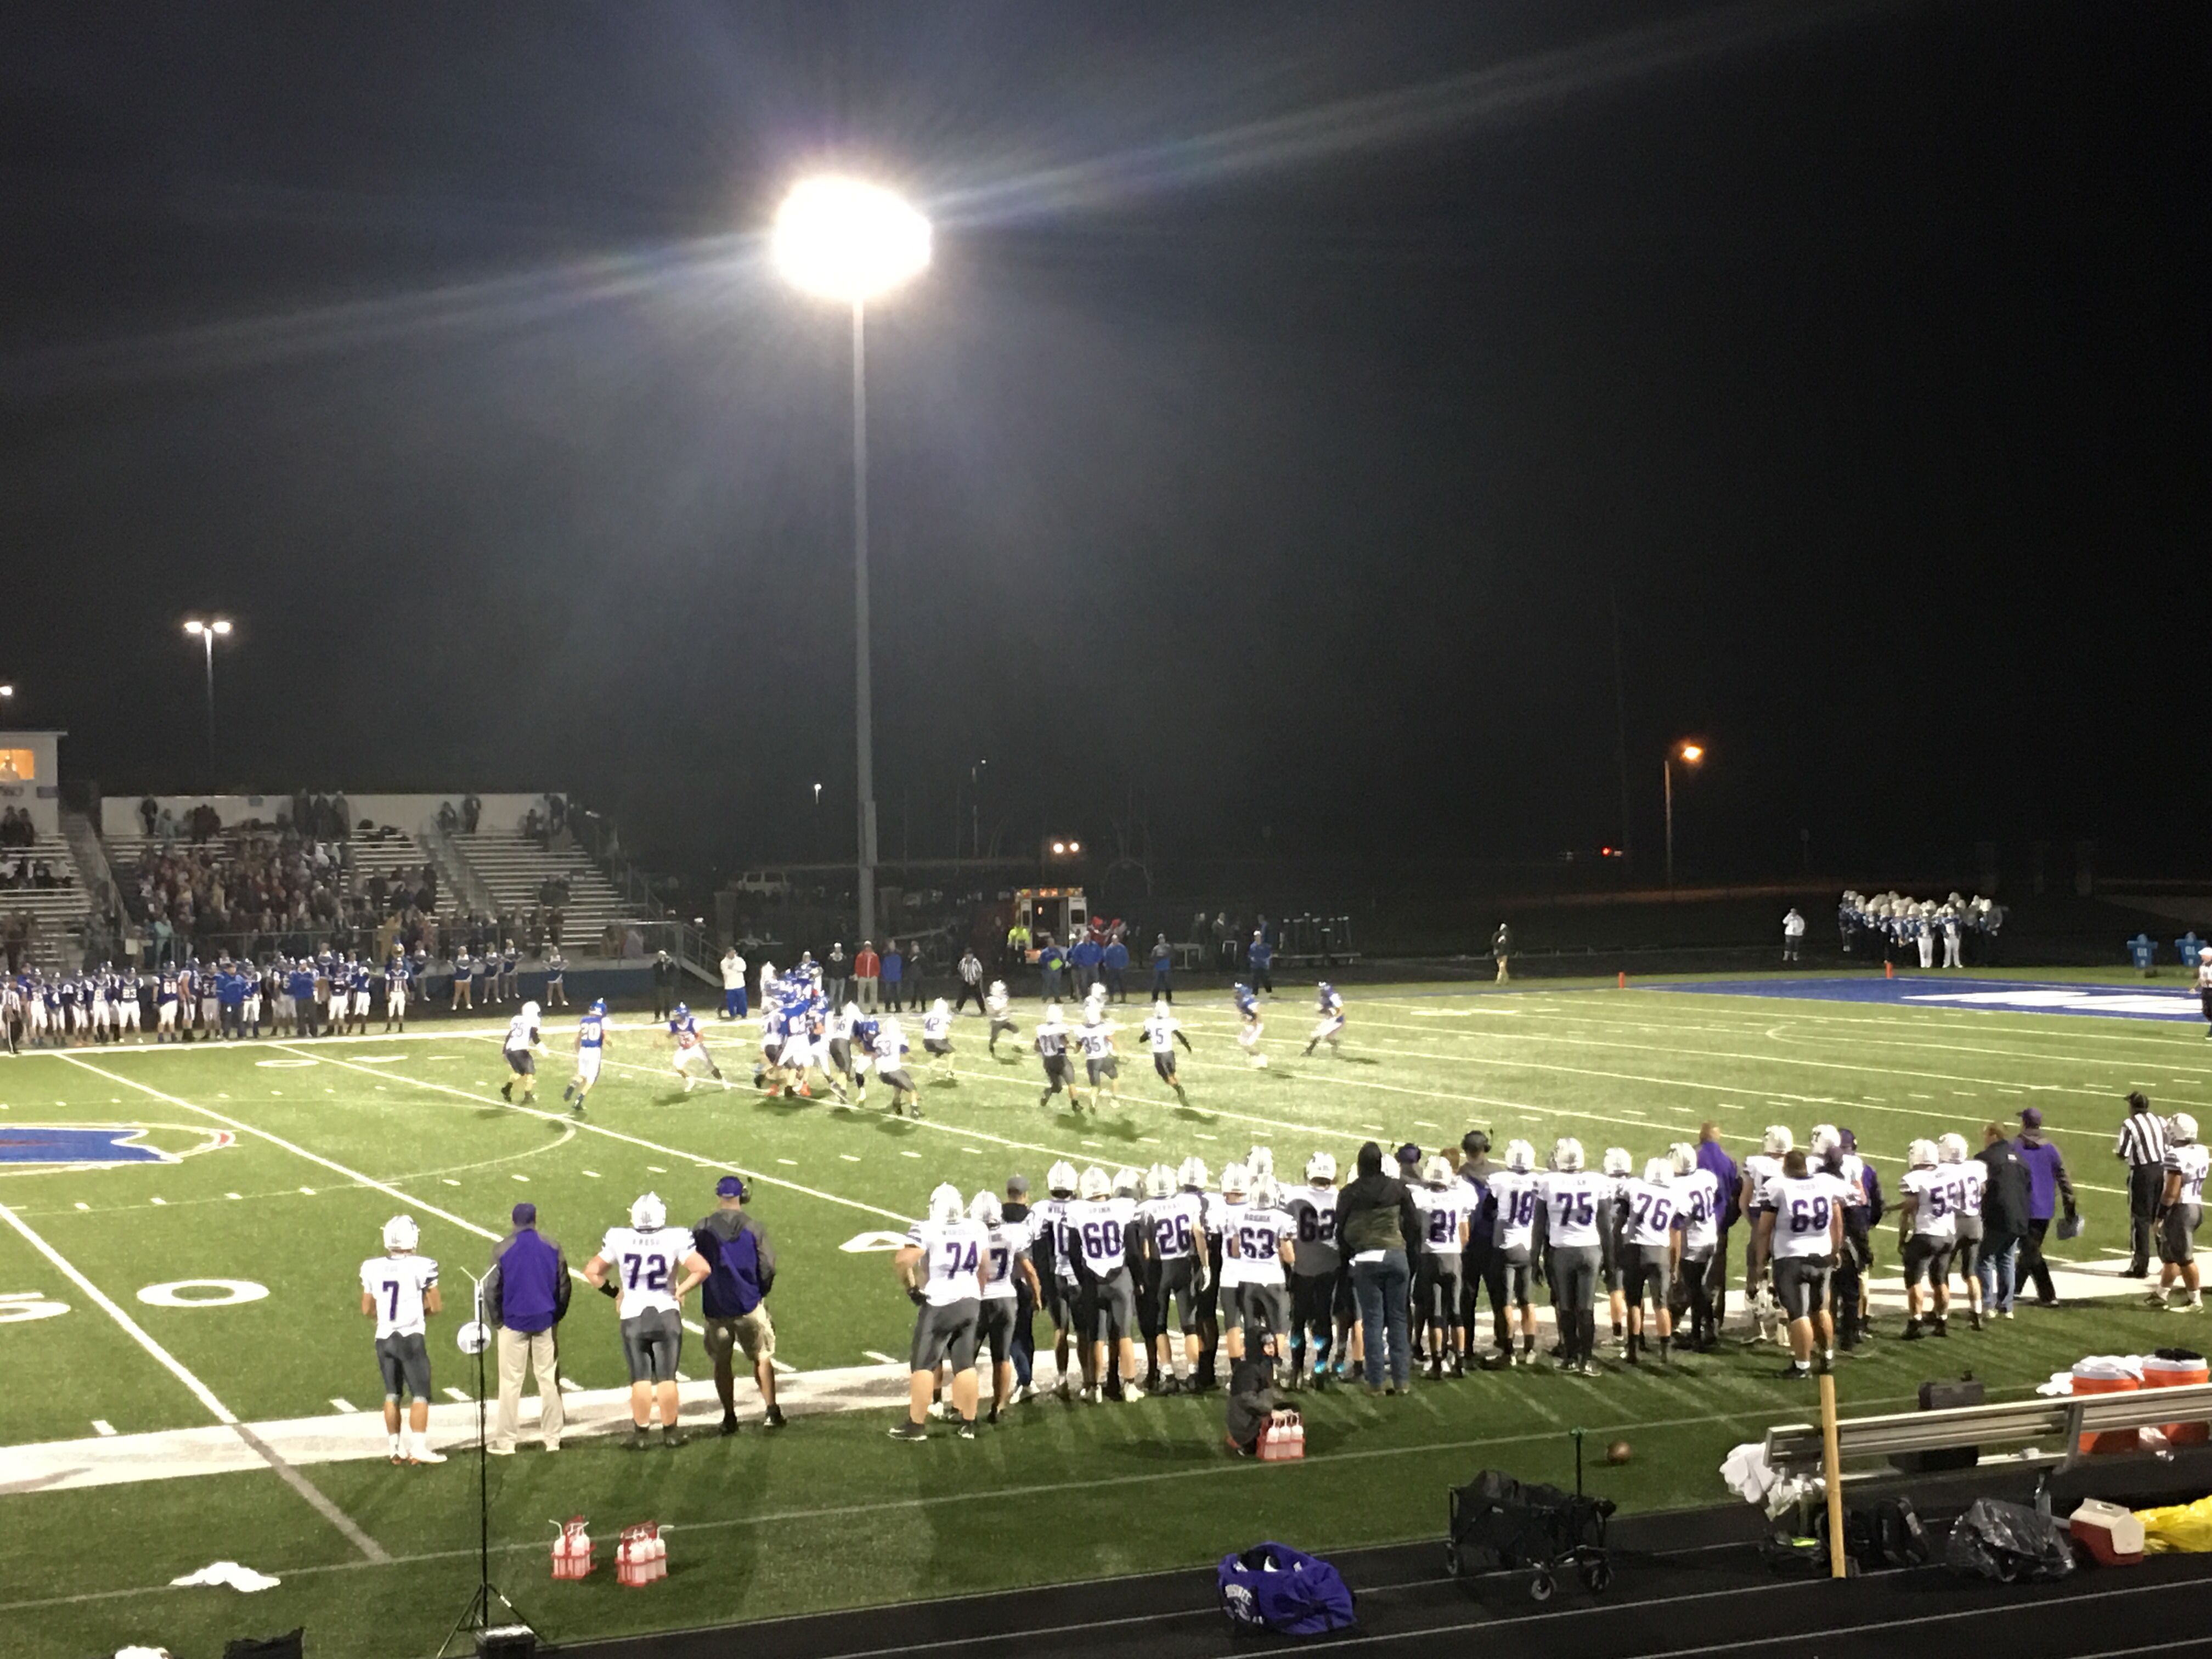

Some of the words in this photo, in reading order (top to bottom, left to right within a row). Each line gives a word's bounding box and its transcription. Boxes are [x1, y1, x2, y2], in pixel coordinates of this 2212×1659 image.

[581, 1023, 601, 1040] 20
[1430, 1209, 1457, 1243] 21
[1510, 1190, 1534, 1226] 18
[1556, 1192, 1593, 1226] 75
[1635, 1193, 1671, 1231] 76
[1083, 1220, 1121, 1259] 60
[1156, 1214, 1190, 1254] 26
[624, 1252, 668, 1290] 72
[946, 1240, 978, 1280] 74
[382, 1280, 399, 1322] 7
